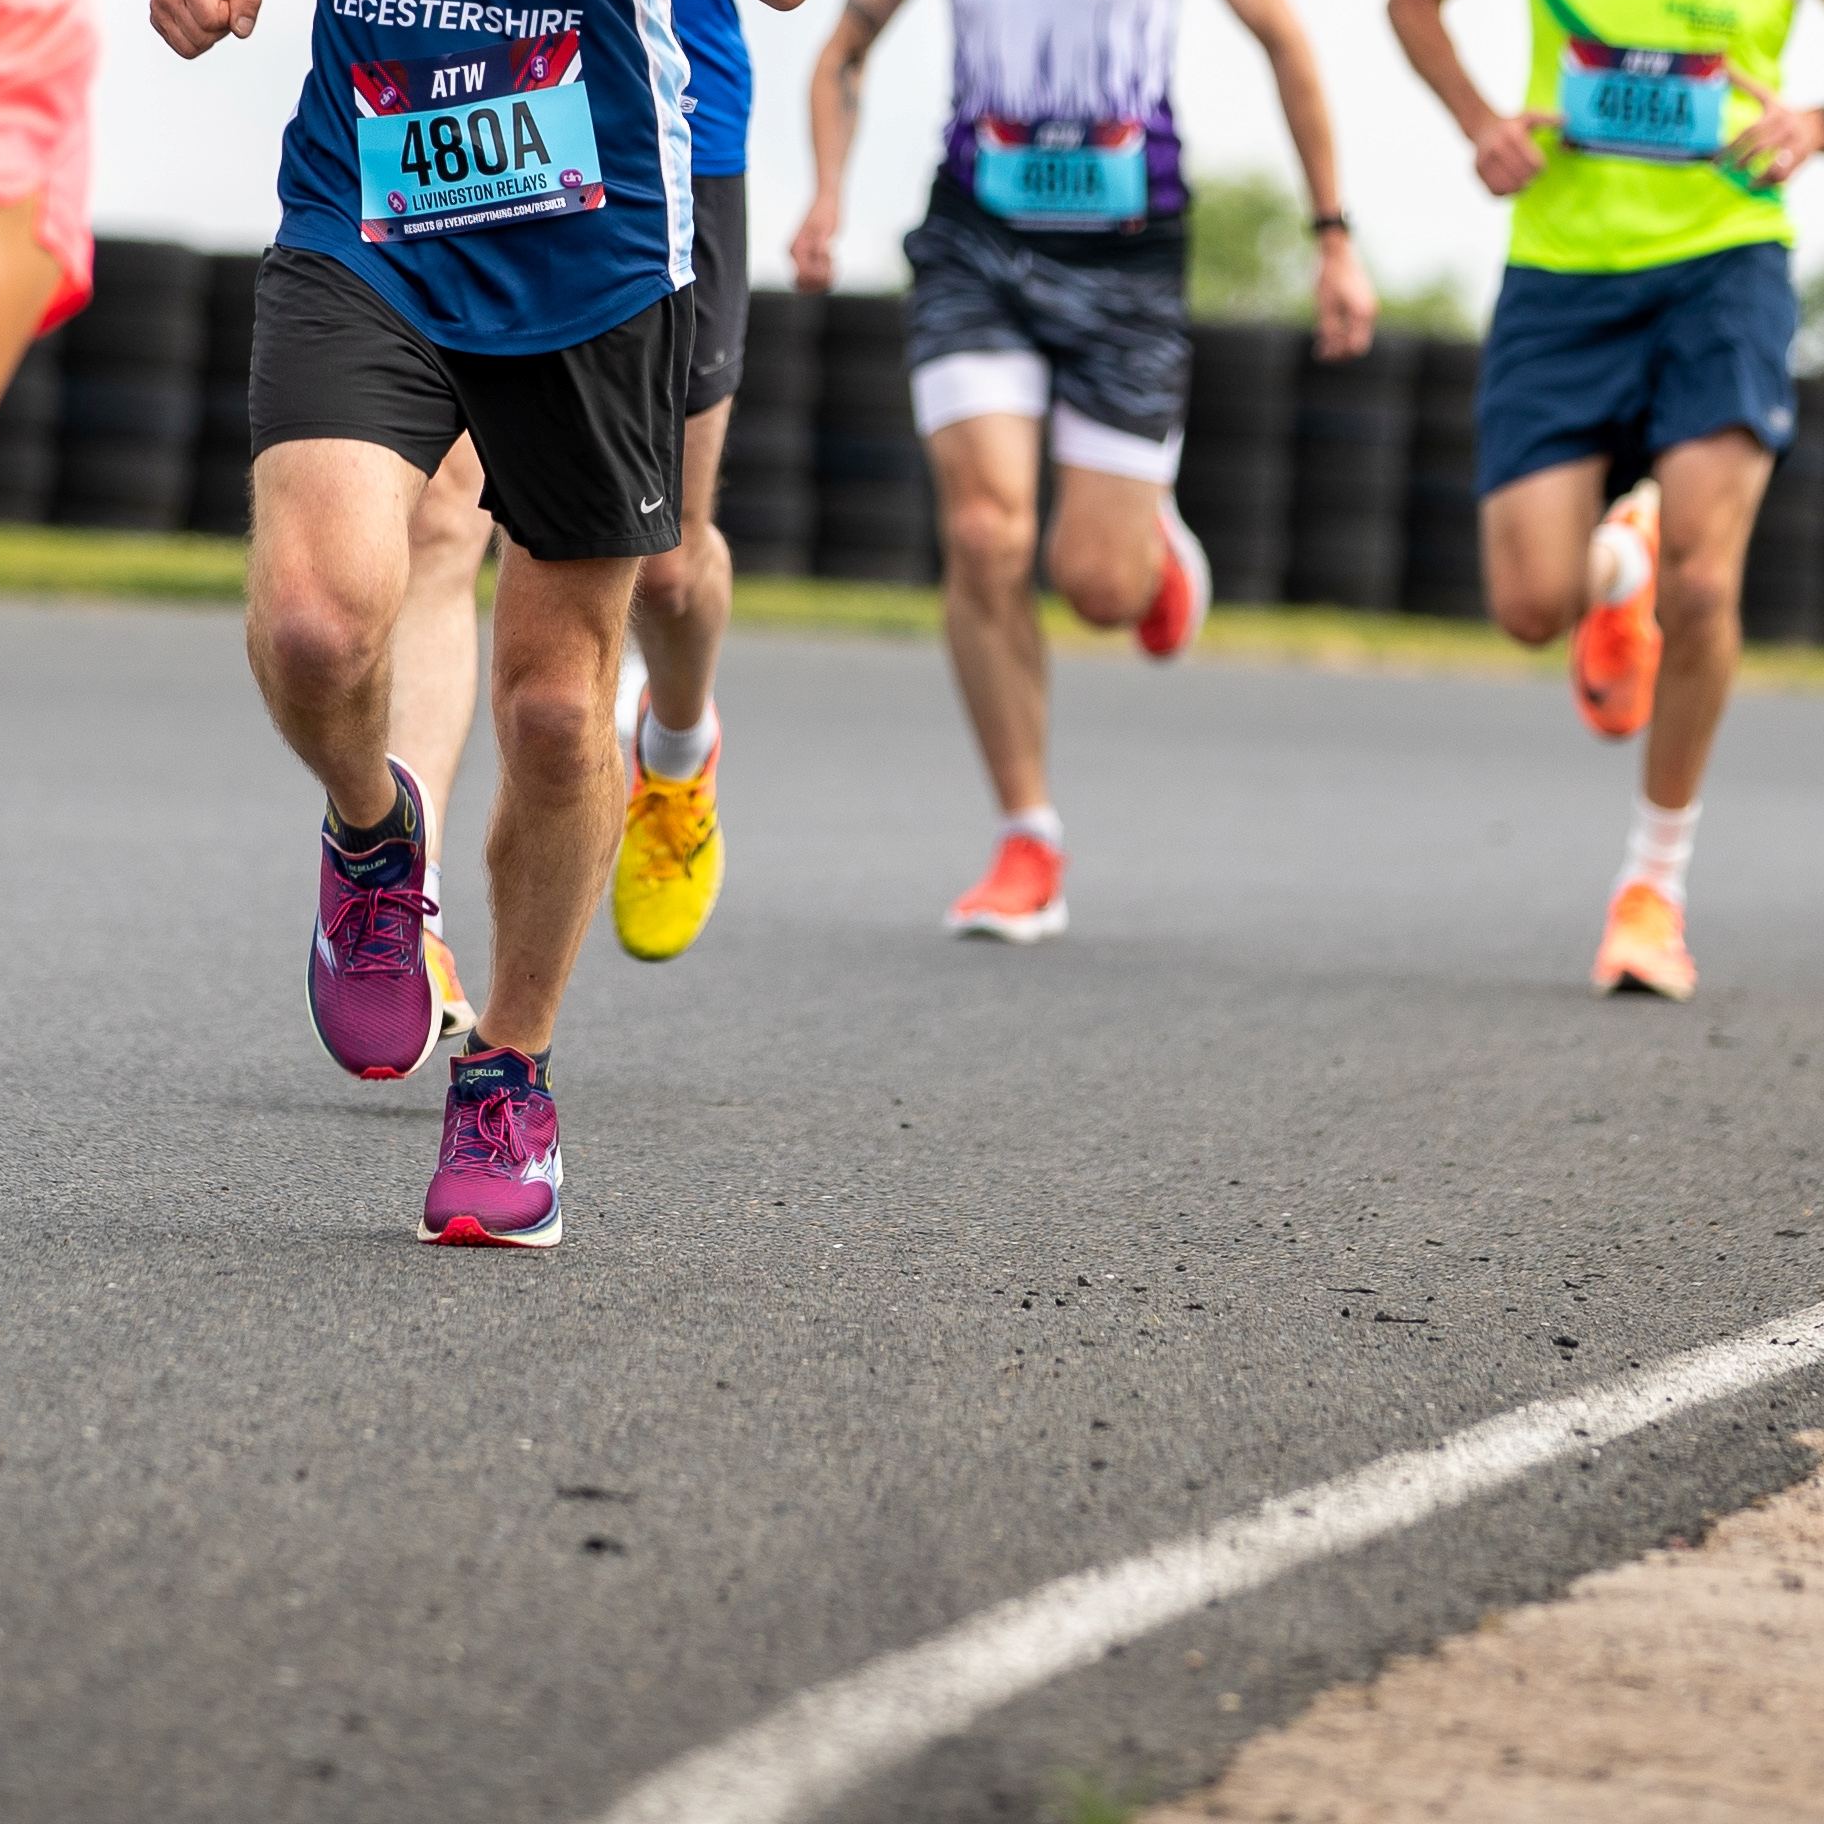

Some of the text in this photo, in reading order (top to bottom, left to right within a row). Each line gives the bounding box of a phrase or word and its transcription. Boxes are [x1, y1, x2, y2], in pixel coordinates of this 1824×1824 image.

[430, 61, 487, 100] ATW
[400, 100, 552, 187] 480A
[412, 173, 548, 212] LIVINGSTON RELAYS
[403, 222, 436, 235] RESULTS
[435, 219, 444, 231] @
